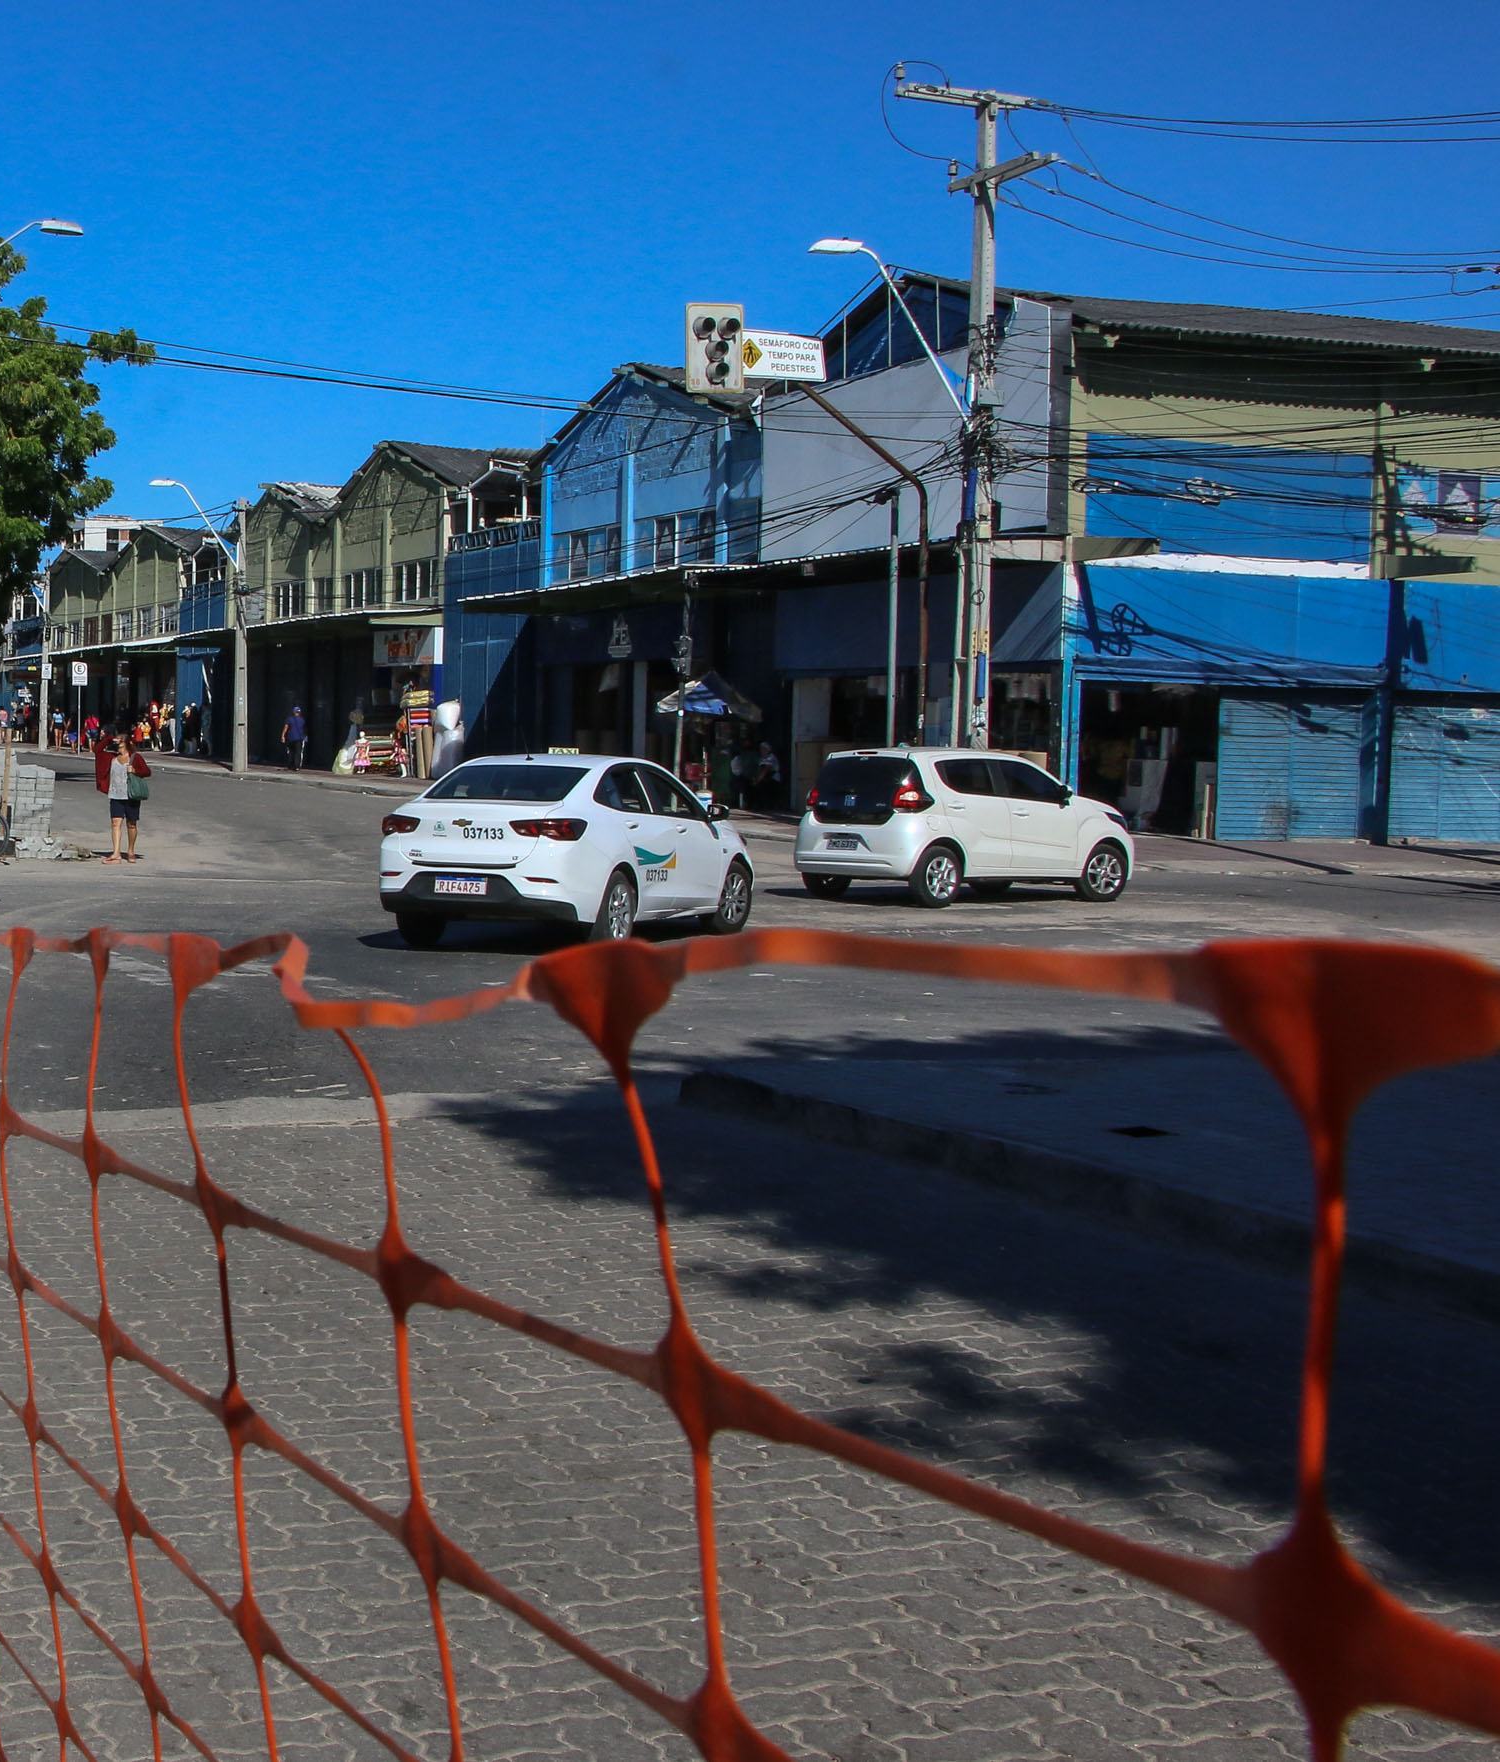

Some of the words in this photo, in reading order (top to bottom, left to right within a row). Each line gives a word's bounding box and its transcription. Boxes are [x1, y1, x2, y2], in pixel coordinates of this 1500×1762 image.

[758, 338, 800, 350] SEMÁFORO
[803, 342, 819, 350] COM
[768, 351, 794, 360] TEMPO
[795, 353, 816, 361] PARA
[770, 363, 816, 373] PEDESTRES
[463, 827, 504, 840] 037133
[645, 869, 668, 882] 037133
